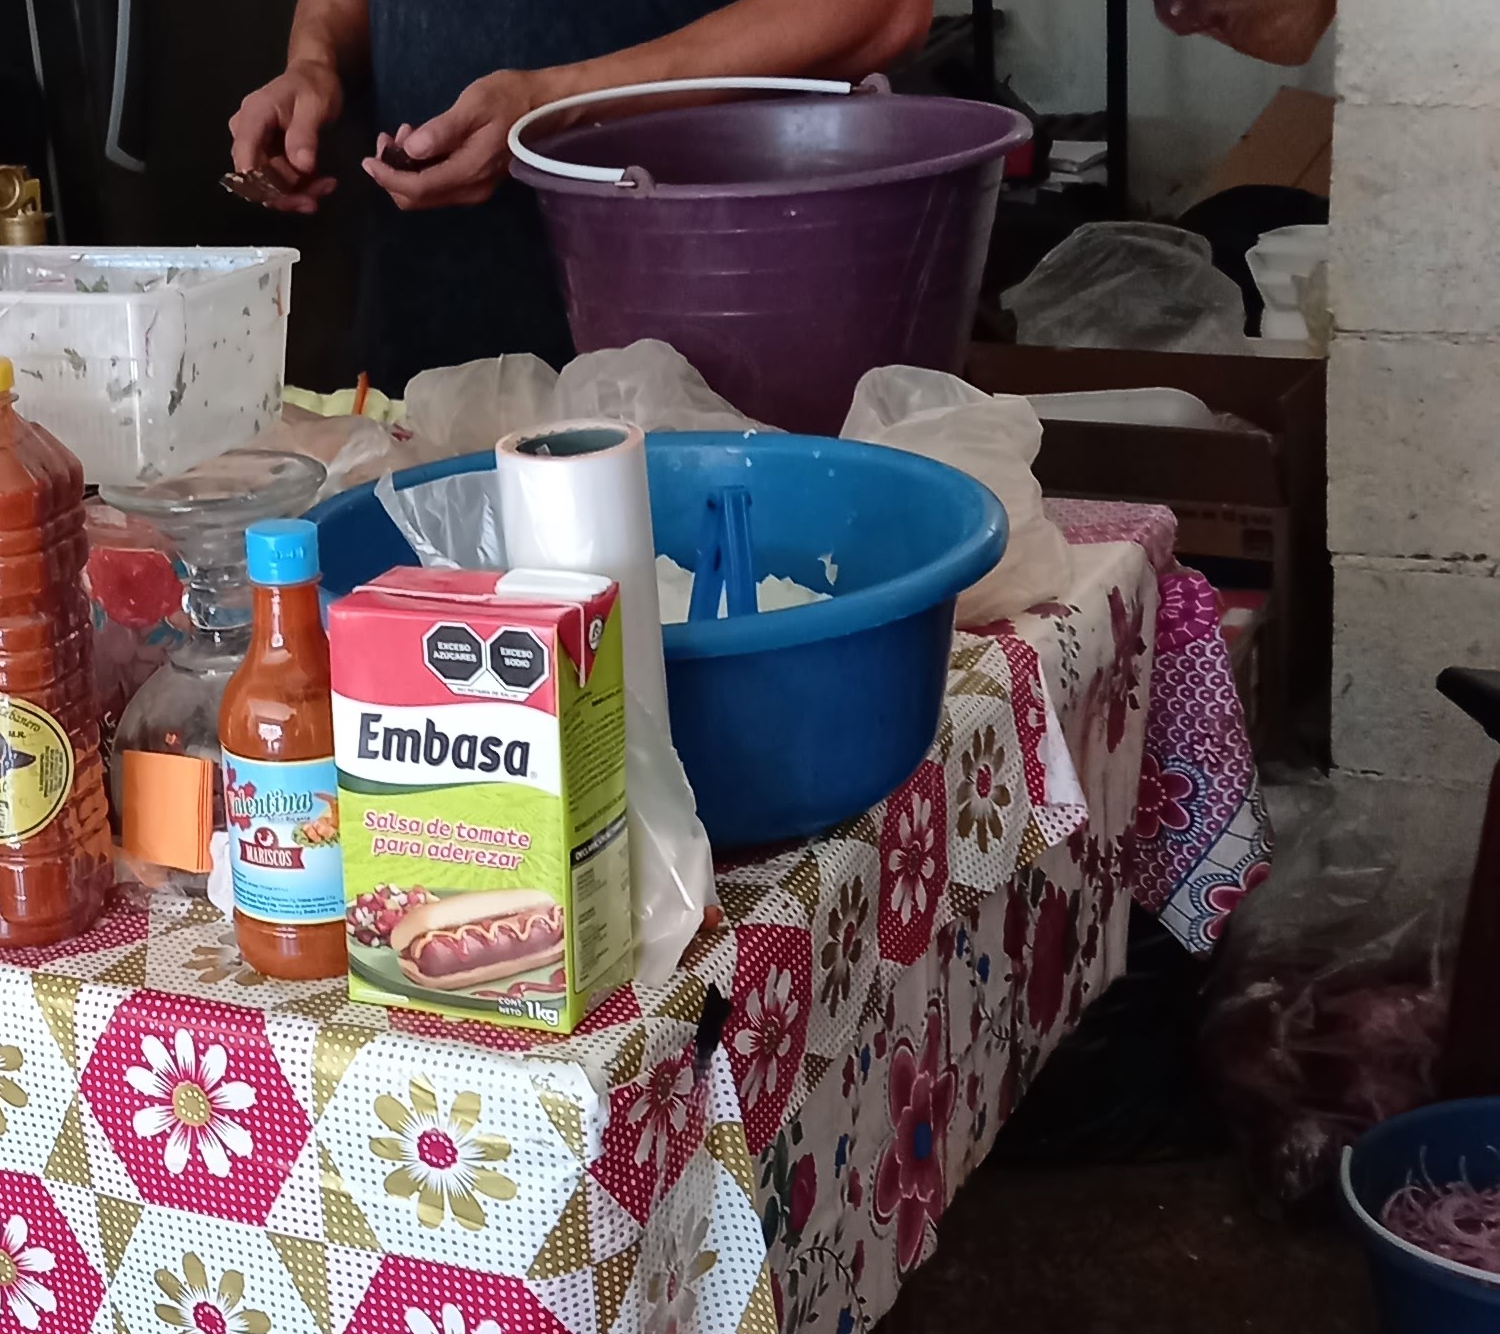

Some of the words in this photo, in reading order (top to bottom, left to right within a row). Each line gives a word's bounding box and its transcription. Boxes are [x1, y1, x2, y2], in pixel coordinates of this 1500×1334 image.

[437, 641, 471, 652] EXCESO
[499, 646, 534, 660] EXCESO
[504, 657, 531, 669] SODIO
[356, 712, 531, 778] Embasa
[227, 789, 313, 818] Valentina
[364, 811, 423, 833] Salsa
[426, 818, 452, 838] de
[455, 822, 531, 848] tomate
[246, 844, 292, 867] MARISCOS
[373, 836, 424, 855] para
[427, 842, 522, 869] aderezar
[498, 1005, 523, 1017] NETO
[526, 1000, 559, 1026] 1kg
